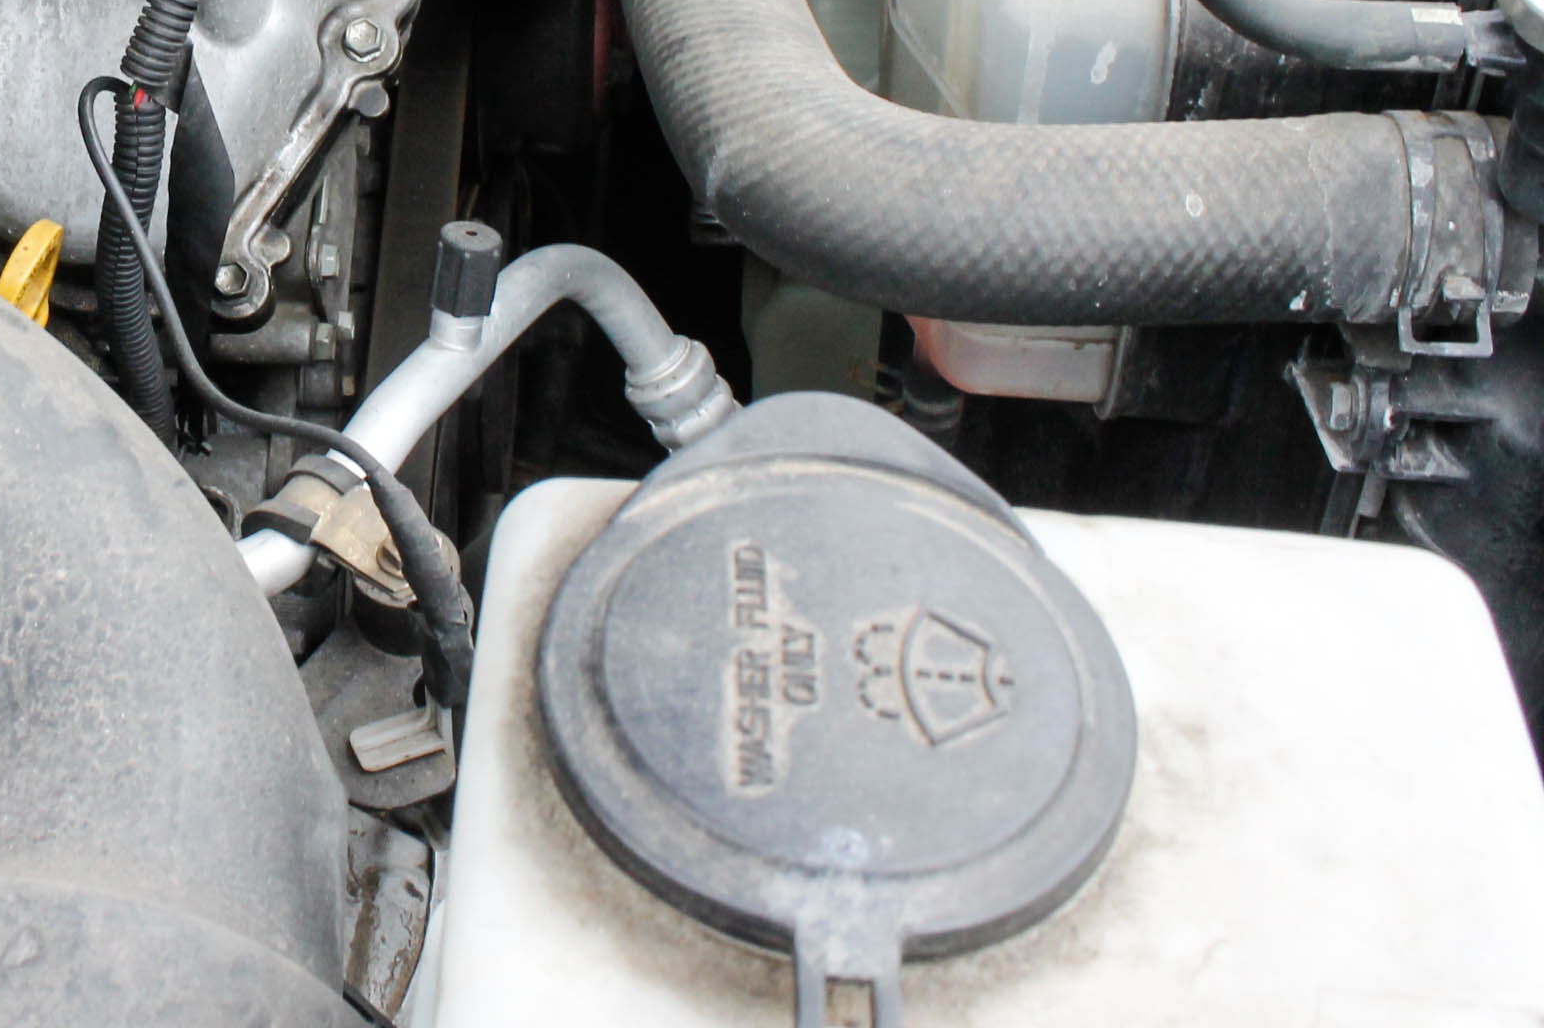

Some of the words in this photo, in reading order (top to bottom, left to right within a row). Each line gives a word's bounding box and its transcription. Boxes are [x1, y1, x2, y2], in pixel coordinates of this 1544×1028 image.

[734, 544, 769, 629] FLUID
[781, 624, 817, 706] ONLY
[735, 649, 773, 787] WASHER
